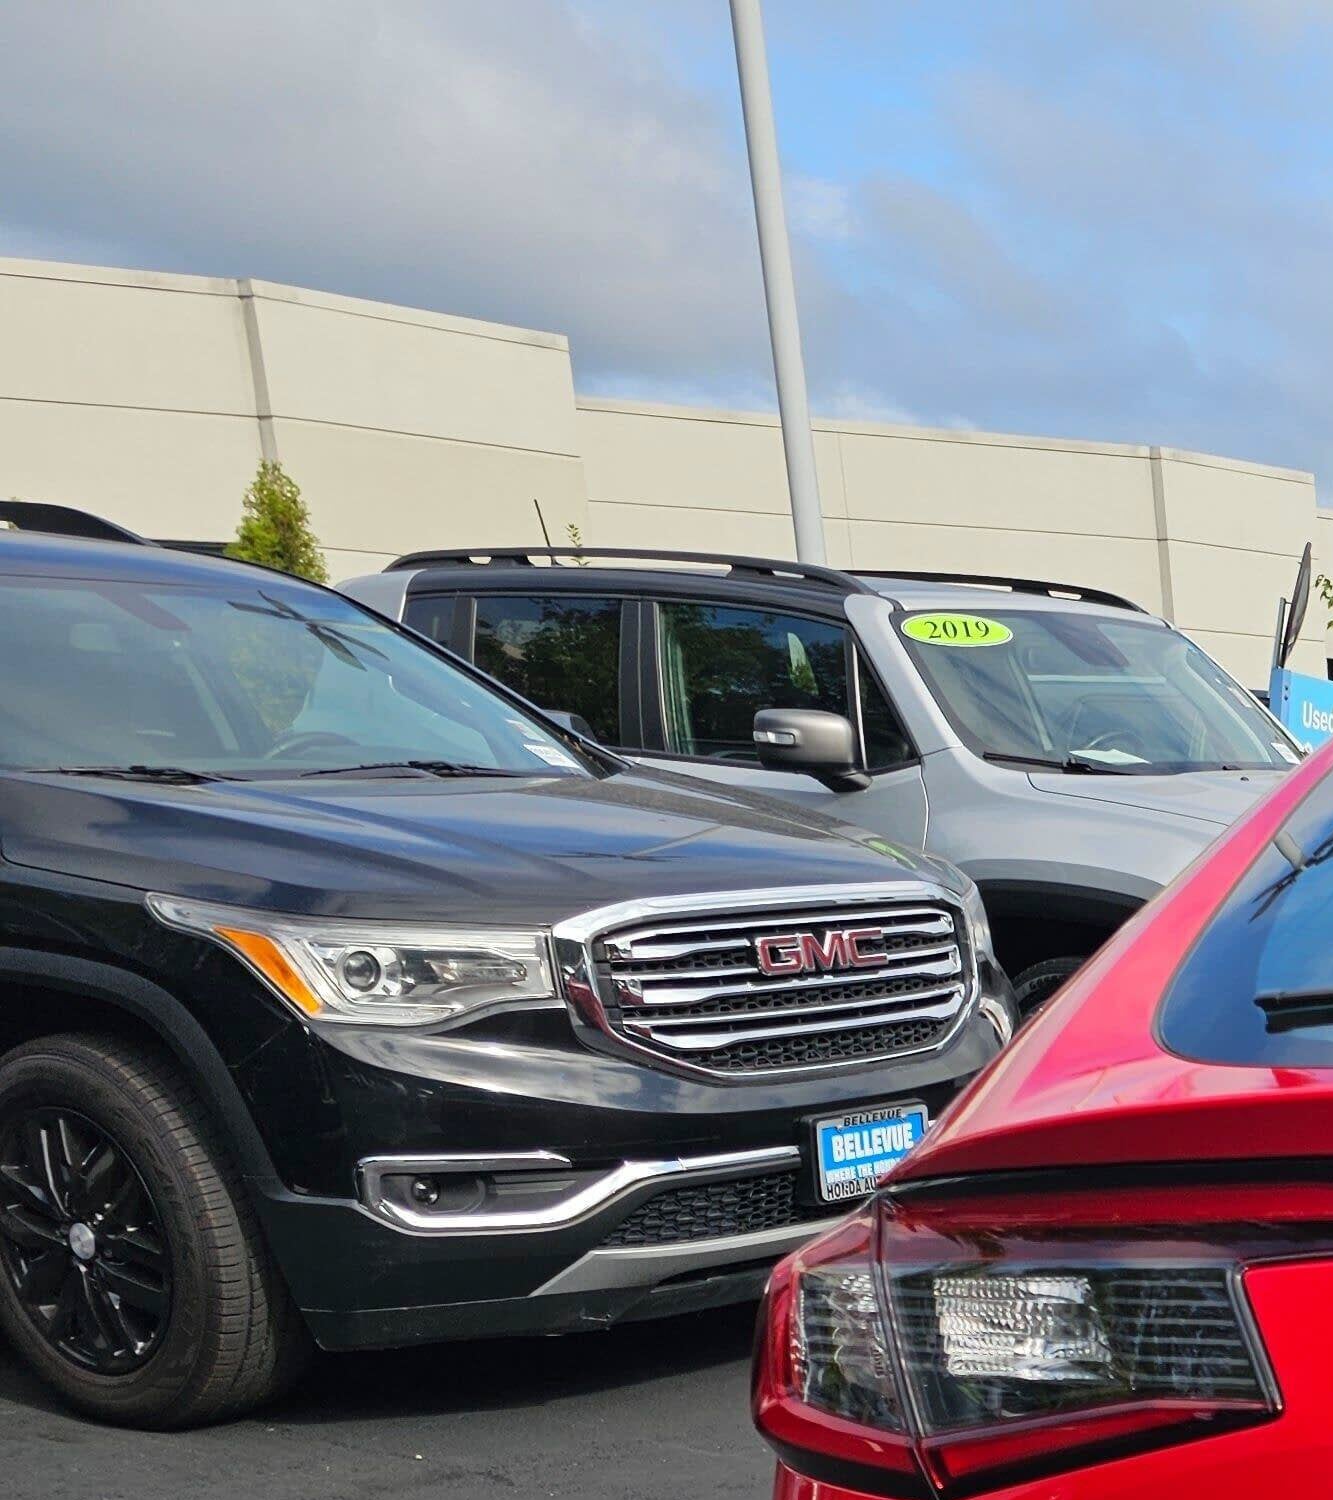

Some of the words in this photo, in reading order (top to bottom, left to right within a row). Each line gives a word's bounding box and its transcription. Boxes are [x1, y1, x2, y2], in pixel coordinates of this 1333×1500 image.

[924, 620, 990, 639] 2019
[755, 927, 888, 976] GMC
[843, 1108, 902, 1127] BELLEVUE
[831, 1122, 914, 1163] BELLEVUE
[825, 1165, 857, 1184] WHERE
[857, 1162, 875, 1178] THE
[827, 1179, 862, 1200] HONDA
